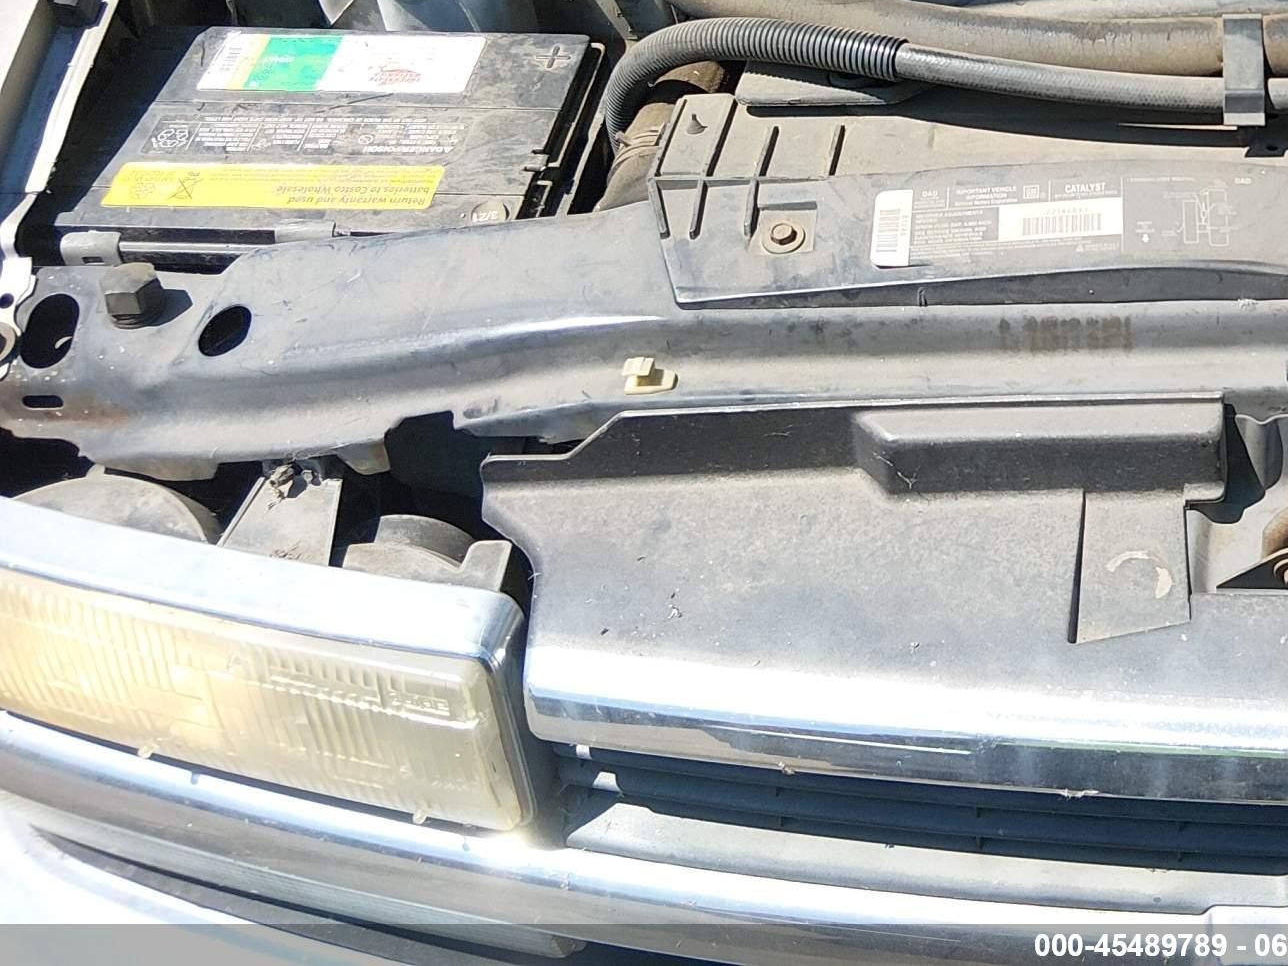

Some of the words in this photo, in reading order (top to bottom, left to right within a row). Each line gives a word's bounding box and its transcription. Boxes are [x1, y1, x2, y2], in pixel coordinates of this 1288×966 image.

[277, 186, 332, 195] Wholesale
[335, 186, 368, 195] Costco
[371, 186, 382, 194] to
[384, 186, 430, 195] batteries
[1064, 182, 1106, 194] CATALYST
[287, 196, 315, 205] used
[317, 196, 337, 205] and
[341, 194, 387, 204] warranty
[389, 196, 425, 206] Return
